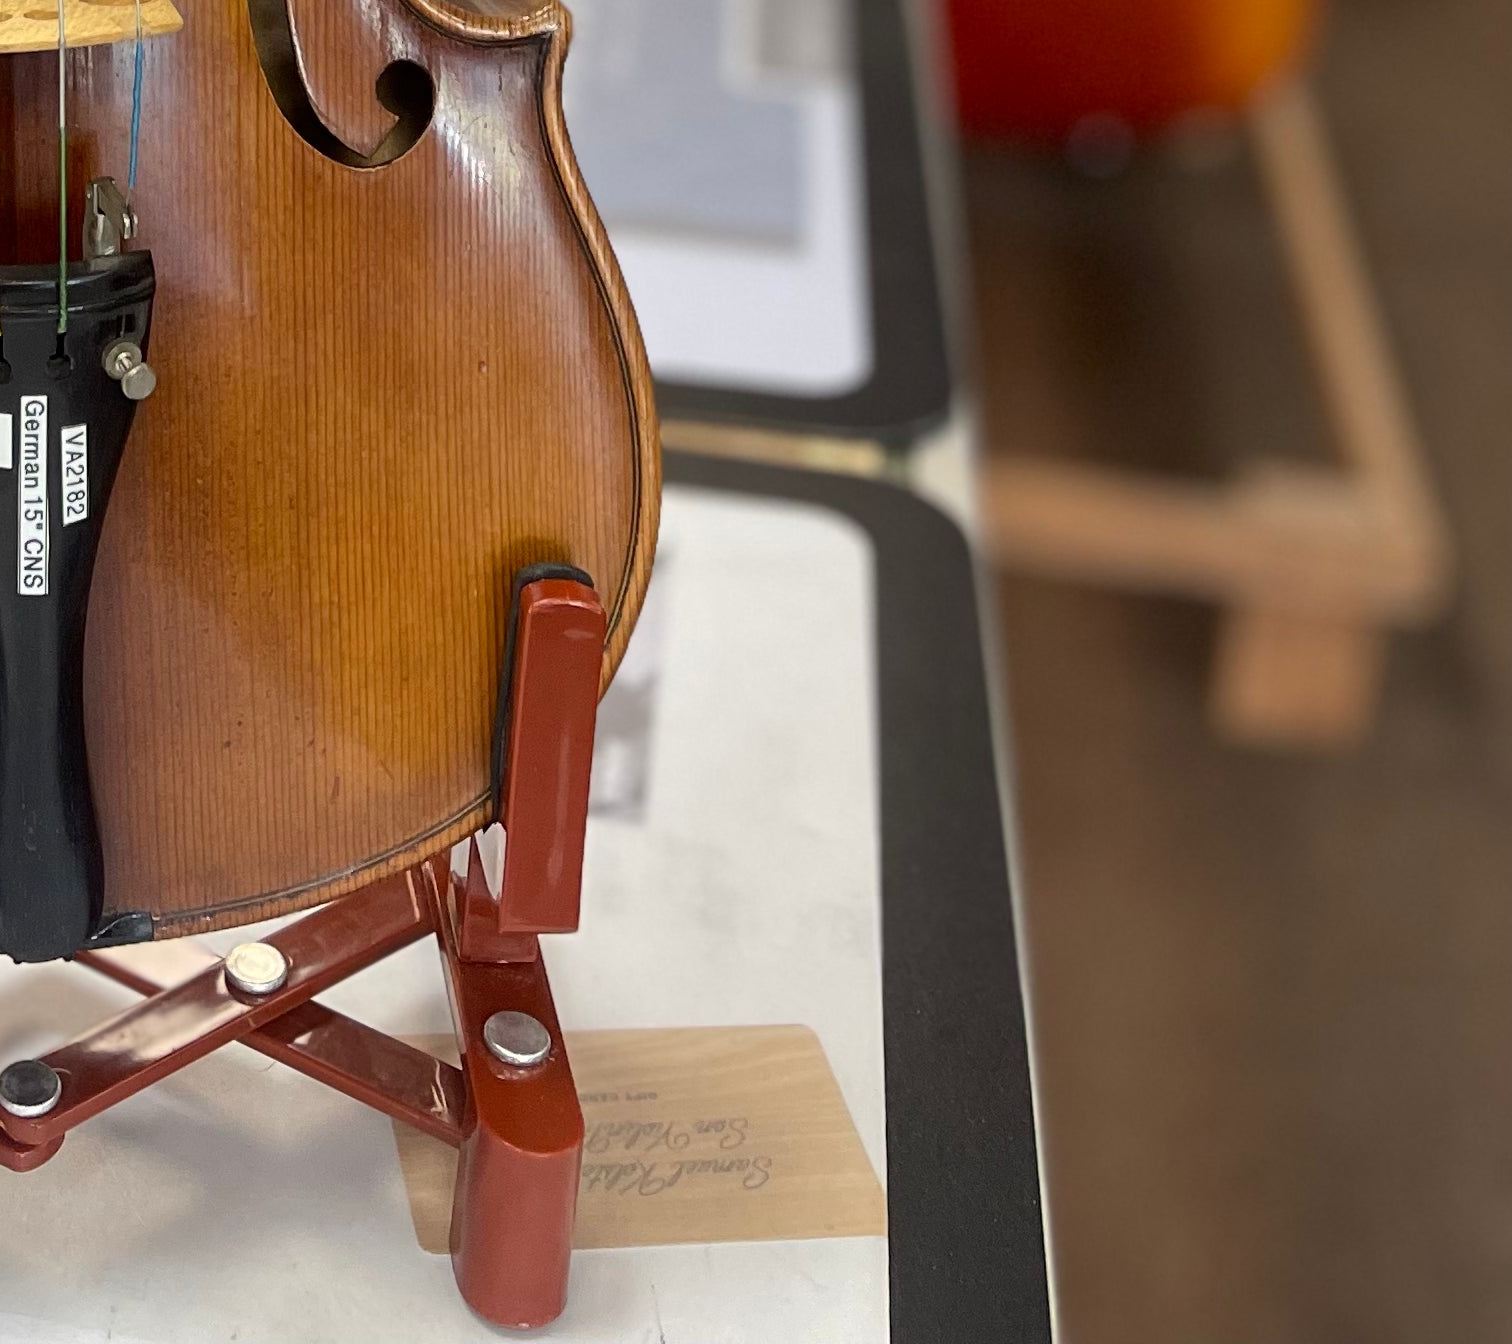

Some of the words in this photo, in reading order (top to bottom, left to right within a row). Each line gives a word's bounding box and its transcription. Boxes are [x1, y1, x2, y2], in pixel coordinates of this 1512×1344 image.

[24, 400, 45, 488] German
[65, 431, 86, 517] VA2182
[24, 496, 43, 530] 15"
[23, 538, 44, 589] CNS
